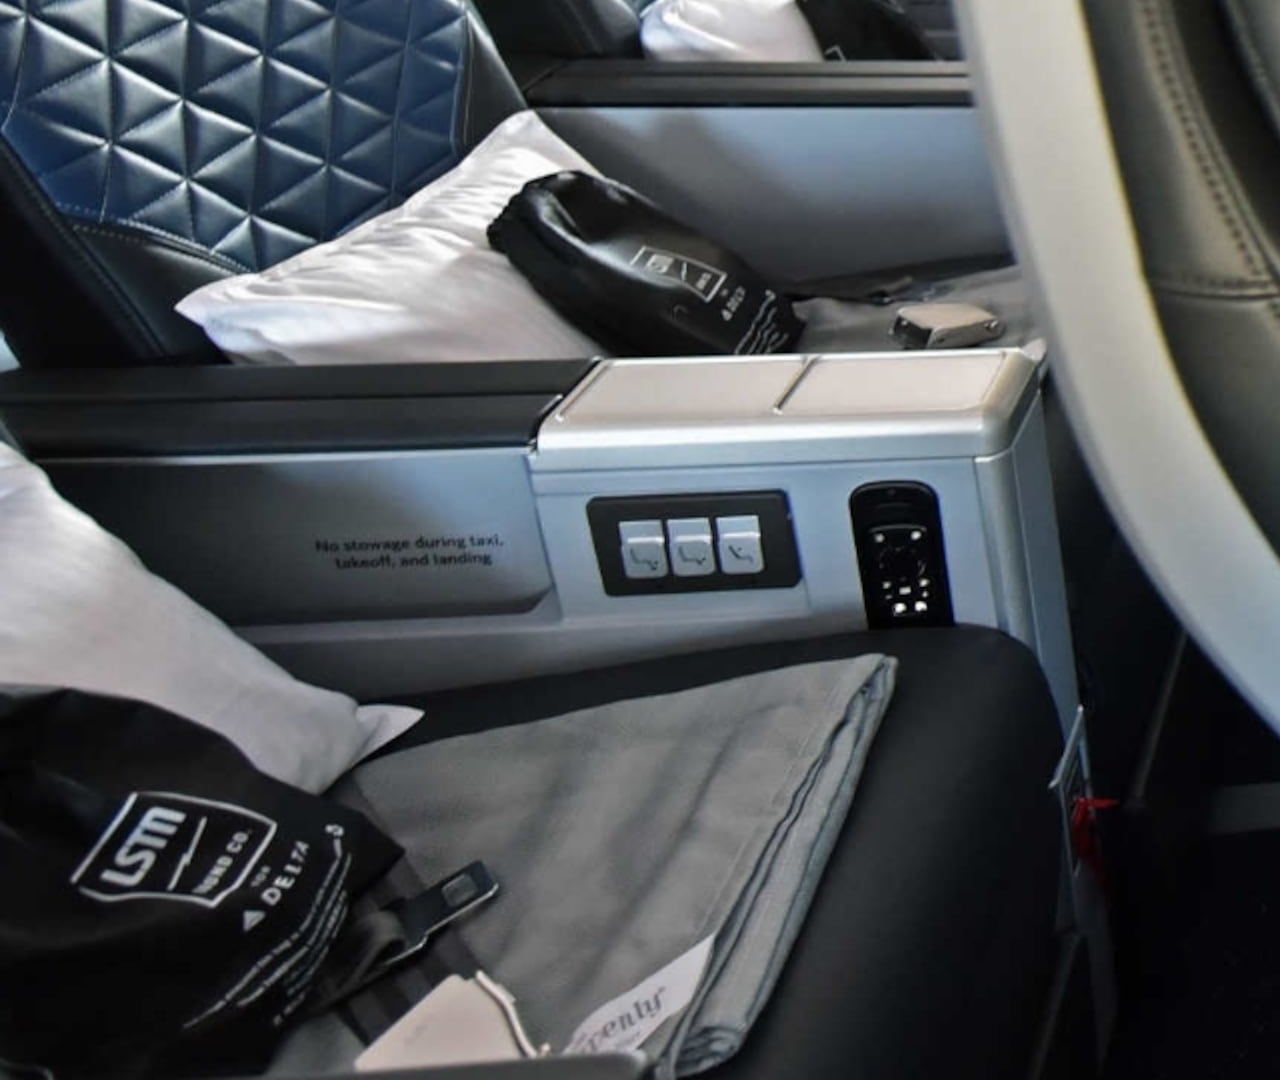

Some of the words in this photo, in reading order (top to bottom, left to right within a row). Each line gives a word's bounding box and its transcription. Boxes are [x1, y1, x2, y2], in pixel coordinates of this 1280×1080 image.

[314, 539, 339, 553] No
[343, 538, 410, 553] stowage
[415, 533, 467, 549] during
[400, 553, 430, 568] and
[432, 550, 493, 567] landing
[261, 840, 310, 906] DELTA
